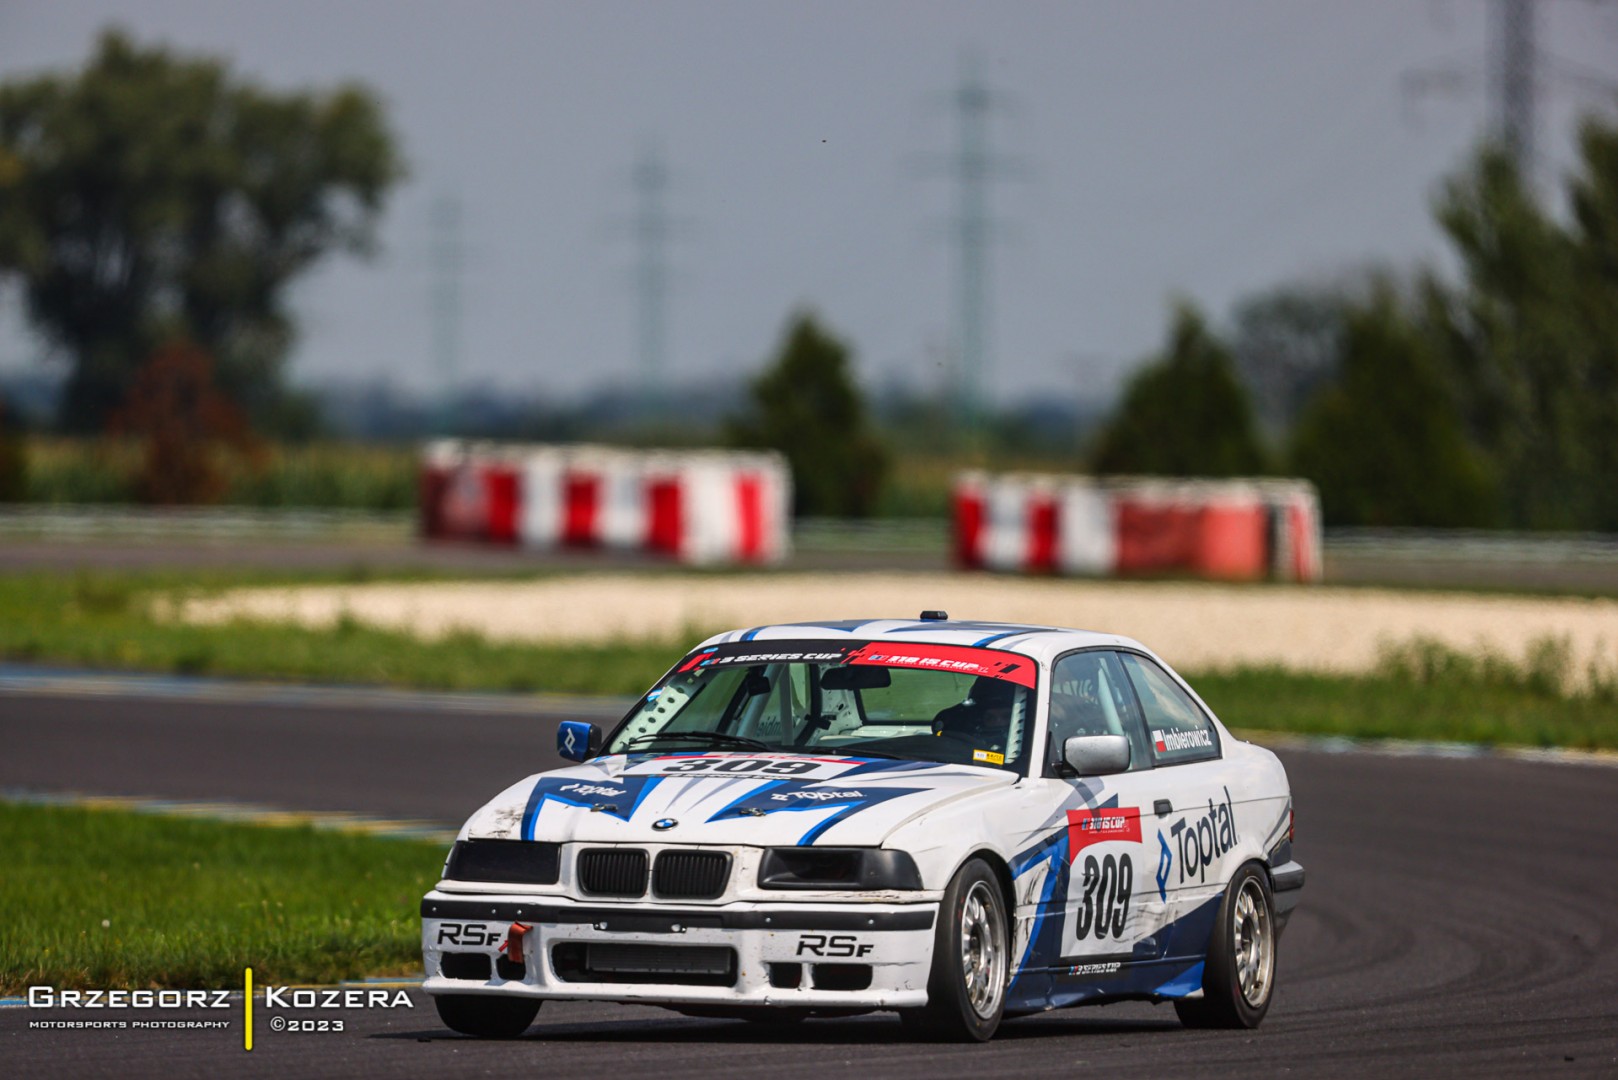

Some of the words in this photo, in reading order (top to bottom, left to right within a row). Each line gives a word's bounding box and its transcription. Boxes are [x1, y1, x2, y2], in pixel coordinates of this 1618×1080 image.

[719, 656, 735, 664] 3
[733, 653, 803, 662] SERIES
[940, 659, 980, 671] CUP
[1162, 725, 1212, 751] Imbierowicz
[662, 759, 822, 775] 309
[787, 790, 864, 801] Toptal
[1110, 816, 1125, 829] CUP
[1171, 786, 1238, 884] Toptal
[1076, 853, 1133, 940] 309
[795, 934, 875, 958] RSF
